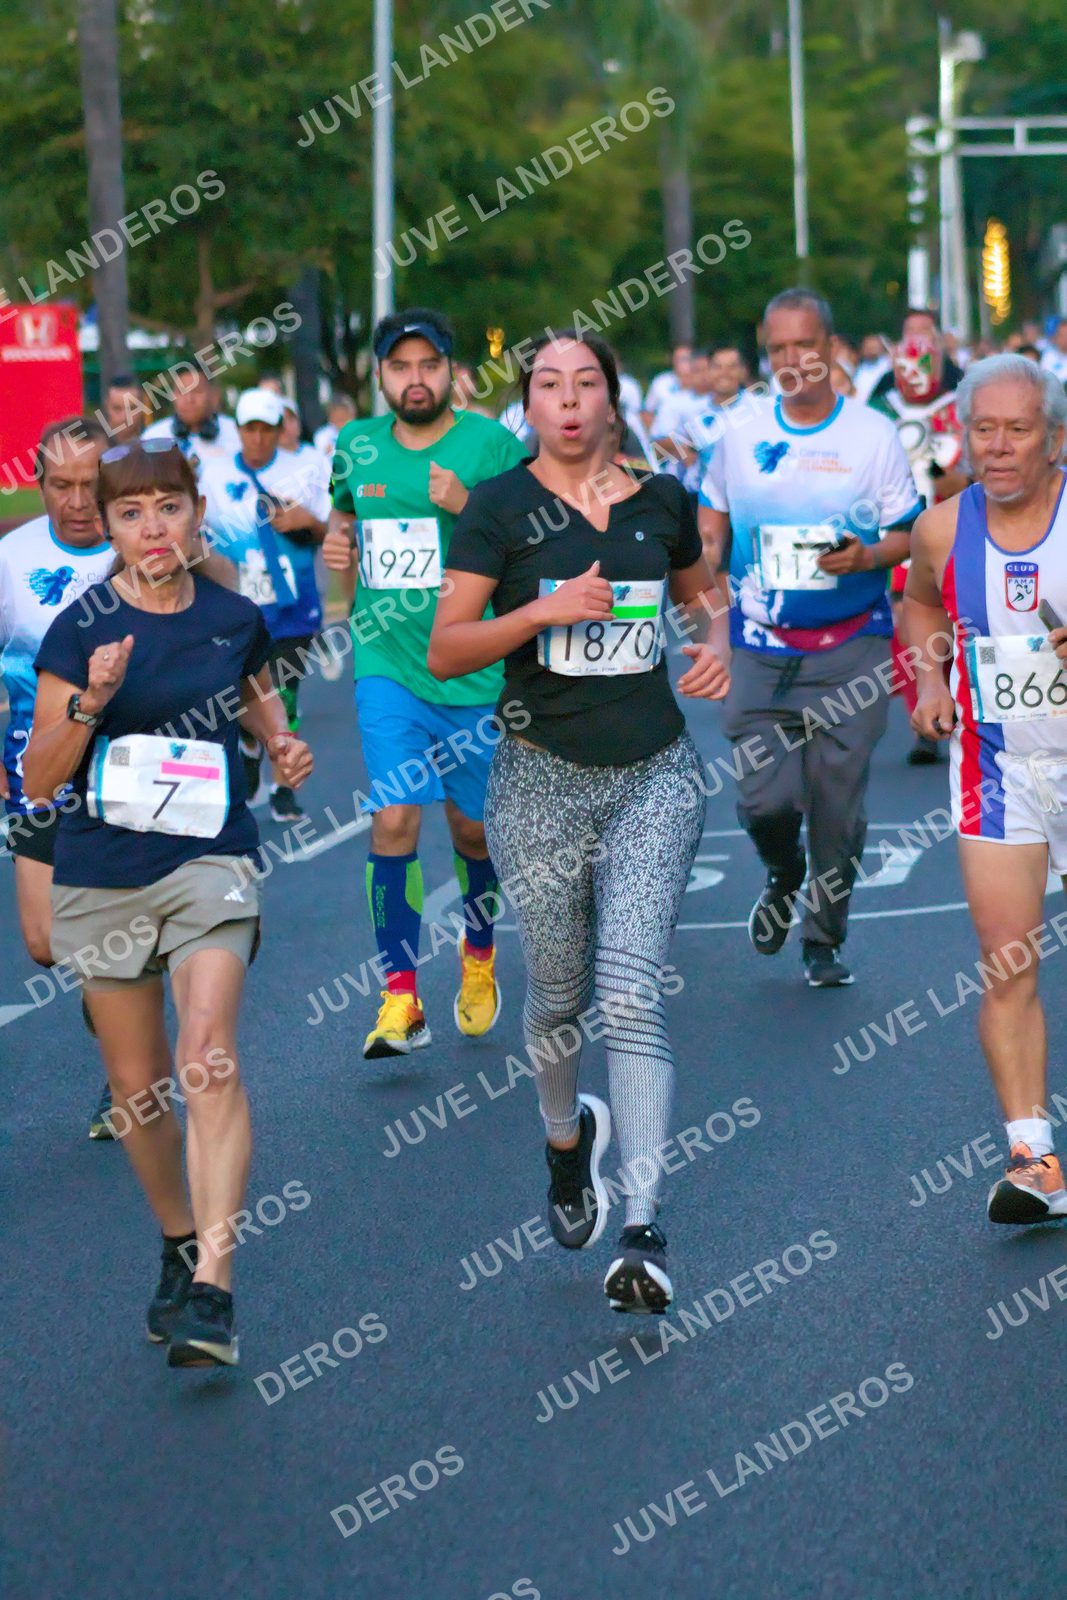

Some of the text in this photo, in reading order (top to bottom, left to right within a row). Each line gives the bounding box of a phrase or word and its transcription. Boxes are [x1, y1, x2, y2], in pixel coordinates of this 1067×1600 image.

[366, 549, 437, 580] 1927
[1006, 564, 1035, 572] CLUB
[564, 620, 656, 662] 1870
[995, 669, 1067, 710] 866
[152, 780, 181, 820] 7
